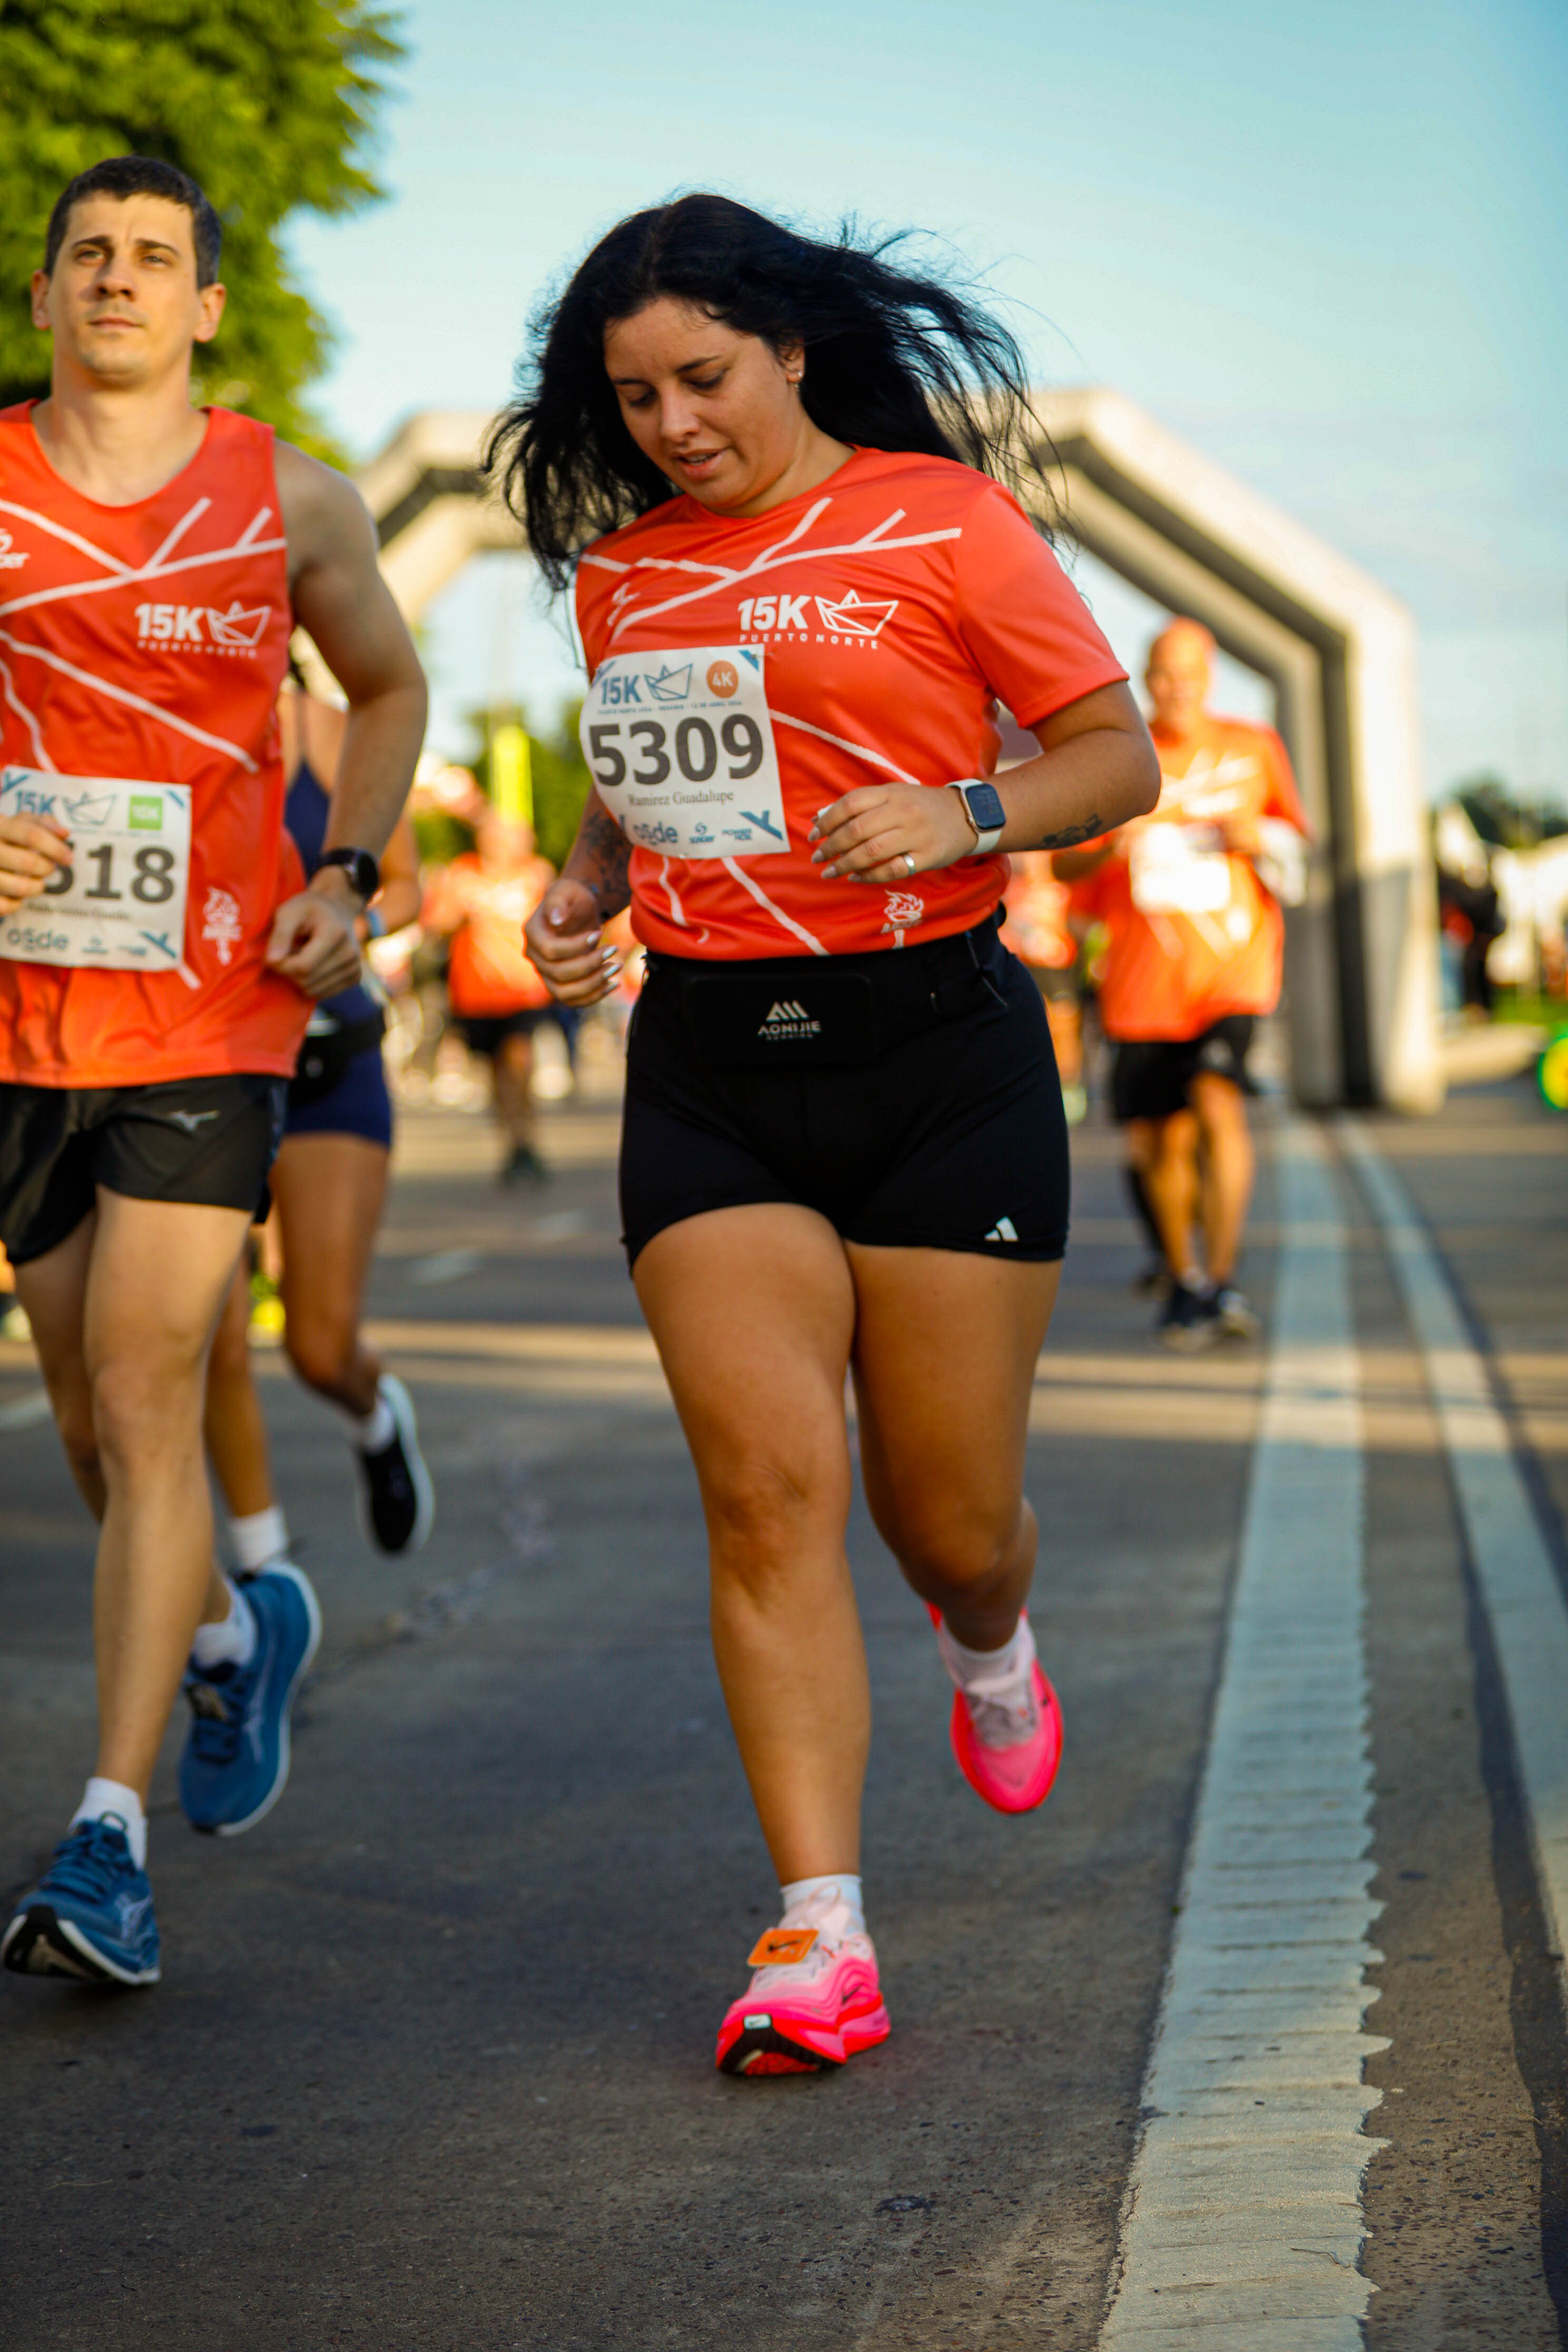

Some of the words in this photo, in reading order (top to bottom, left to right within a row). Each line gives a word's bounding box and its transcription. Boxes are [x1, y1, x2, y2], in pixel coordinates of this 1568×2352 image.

[134, 603, 205, 642] 15K
[738, 594, 811, 630] 15K
[739, 633, 808, 643] PUERTO
[816, 634, 878, 649] NORTE
[601, 674, 642, 705] 15K
[712, 671, 733, 688] 4K
[589, 713, 763, 787] 5309
[15, 790, 56, 816] 15K
[672, 790, 734, 805] Guadalupe
[758, 1021, 820, 1036] AONIJIE
